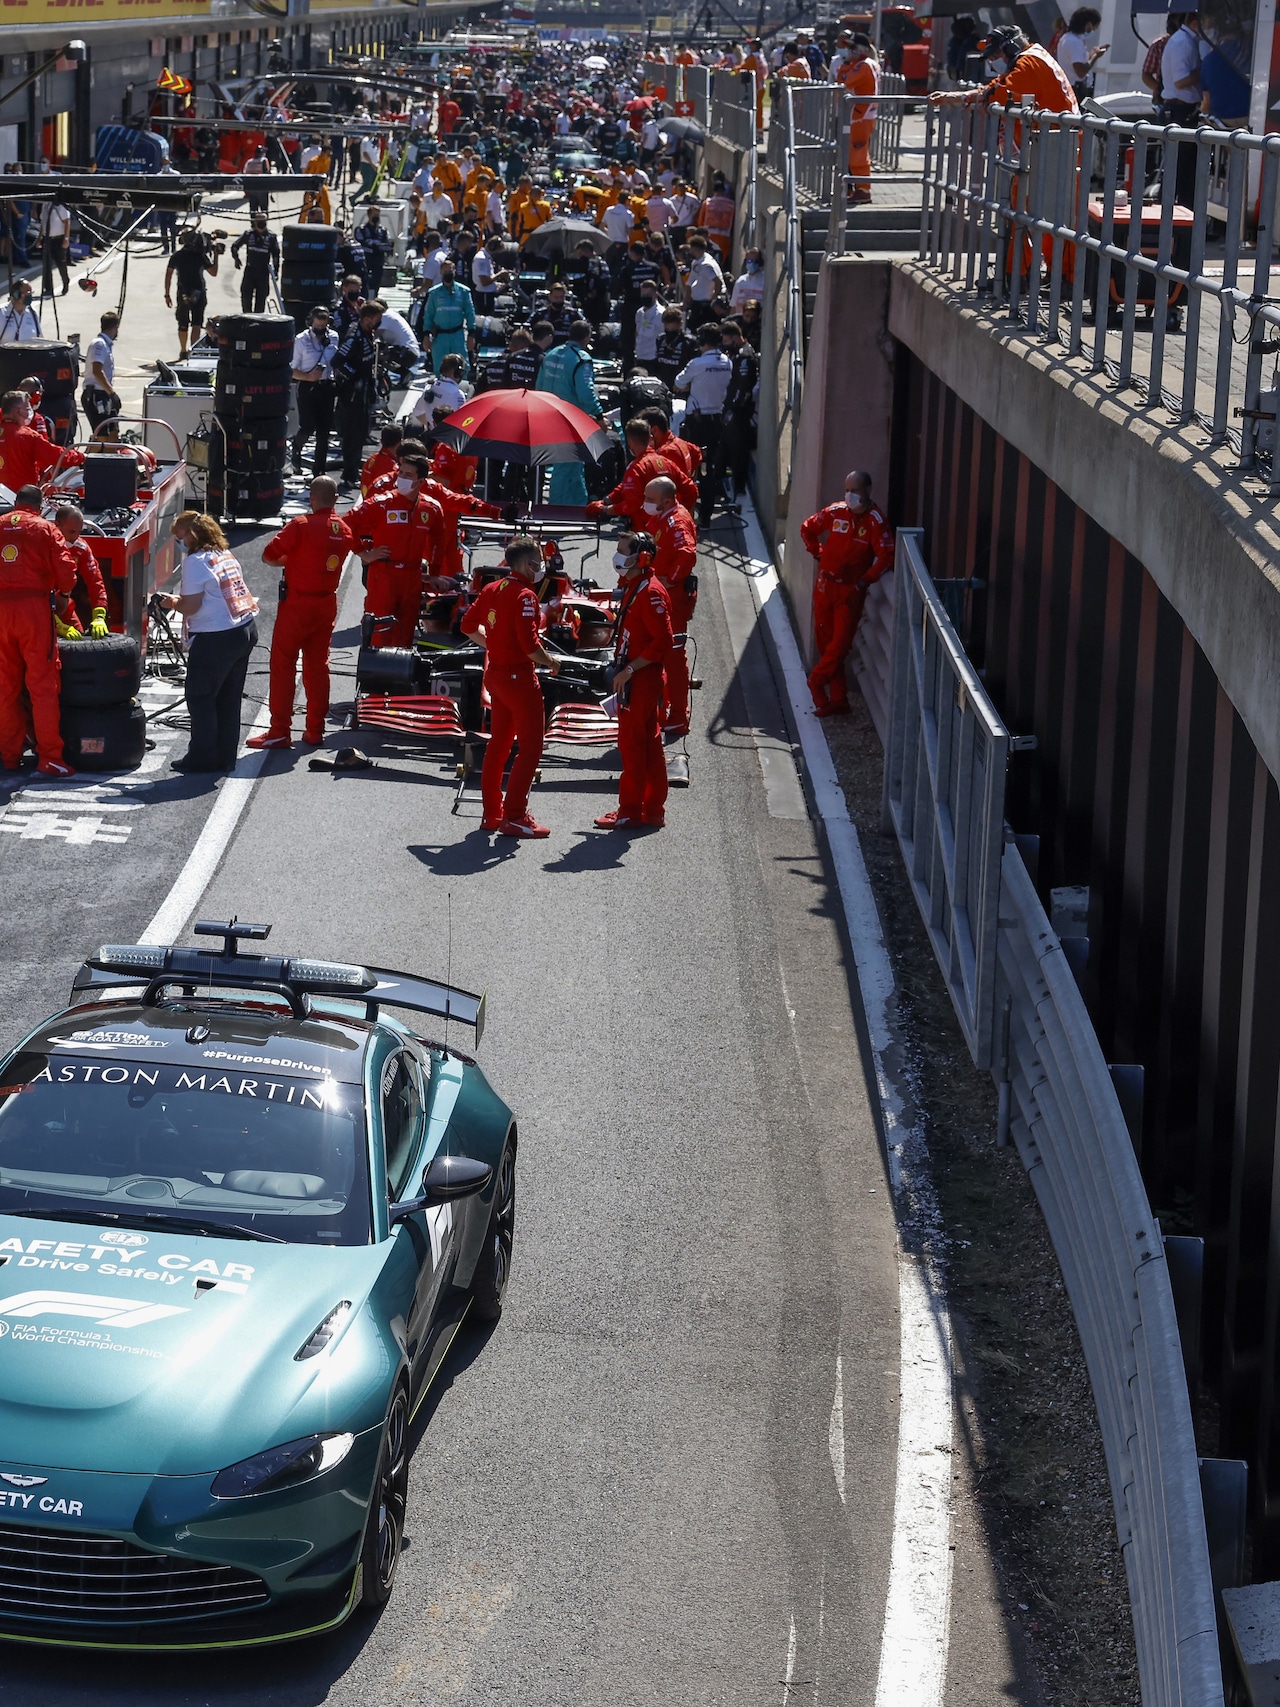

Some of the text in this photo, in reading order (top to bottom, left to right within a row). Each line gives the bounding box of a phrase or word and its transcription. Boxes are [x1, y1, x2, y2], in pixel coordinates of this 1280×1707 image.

[245, 386, 262, 394] LEFT
[94, 1031, 150, 1040] ACTION
[122, 1038, 169, 1047] SAFETY
[202, 1050, 332, 1075] #PurposeDriven
[30, 1065, 326, 1110] ASTON MARTIN
[106, 1232, 144, 1245] FIA
[18, 1255, 185, 1285] Drive Safely
[157, 1254, 256, 1281] CAR
[13, 1324, 112, 1342] FIA Formula 1
[11, 1332, 163, 1360] World Championship
[38, 1496, 83, 1516] CAR
